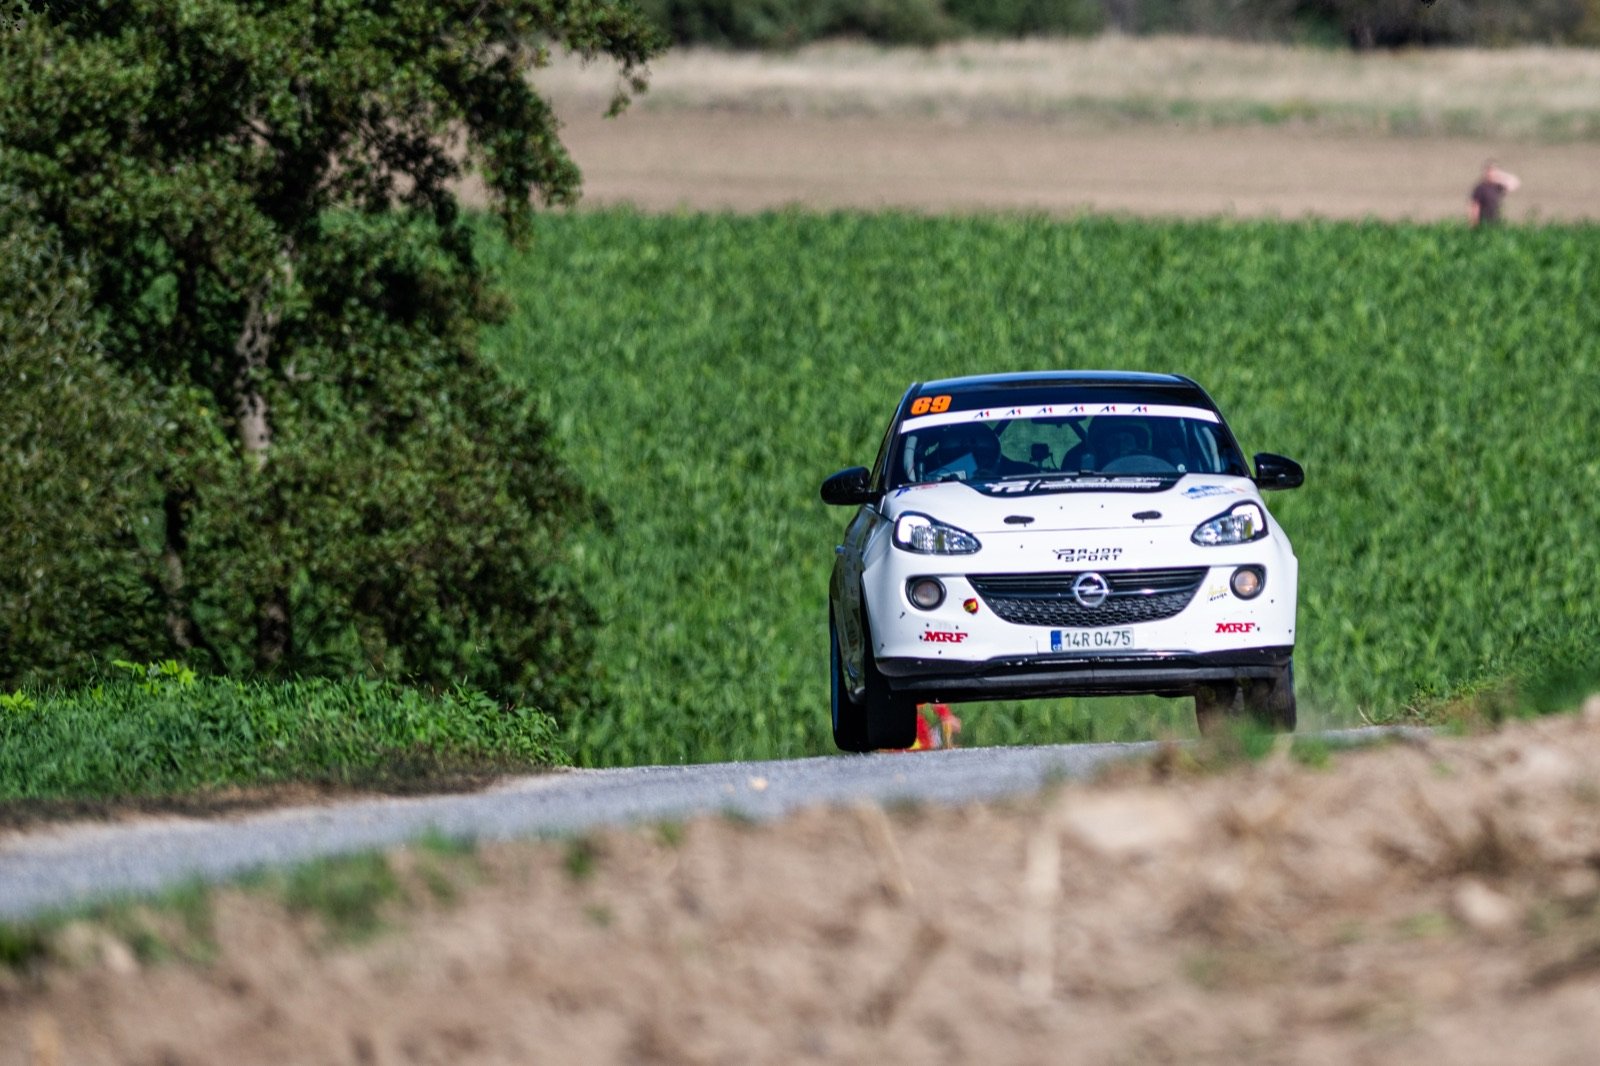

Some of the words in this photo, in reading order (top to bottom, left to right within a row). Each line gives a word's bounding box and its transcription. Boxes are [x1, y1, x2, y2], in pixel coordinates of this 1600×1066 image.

[910, 395, 952, 415] 69
[1065, 554, 1119, 562] SPORT
[1215, 622, 1255, 633] MRF
[923, 630, 968, 643] MRF
[1064, 632, 1090, 647] 14R
[1094, 630, 1131, 646] 0475
